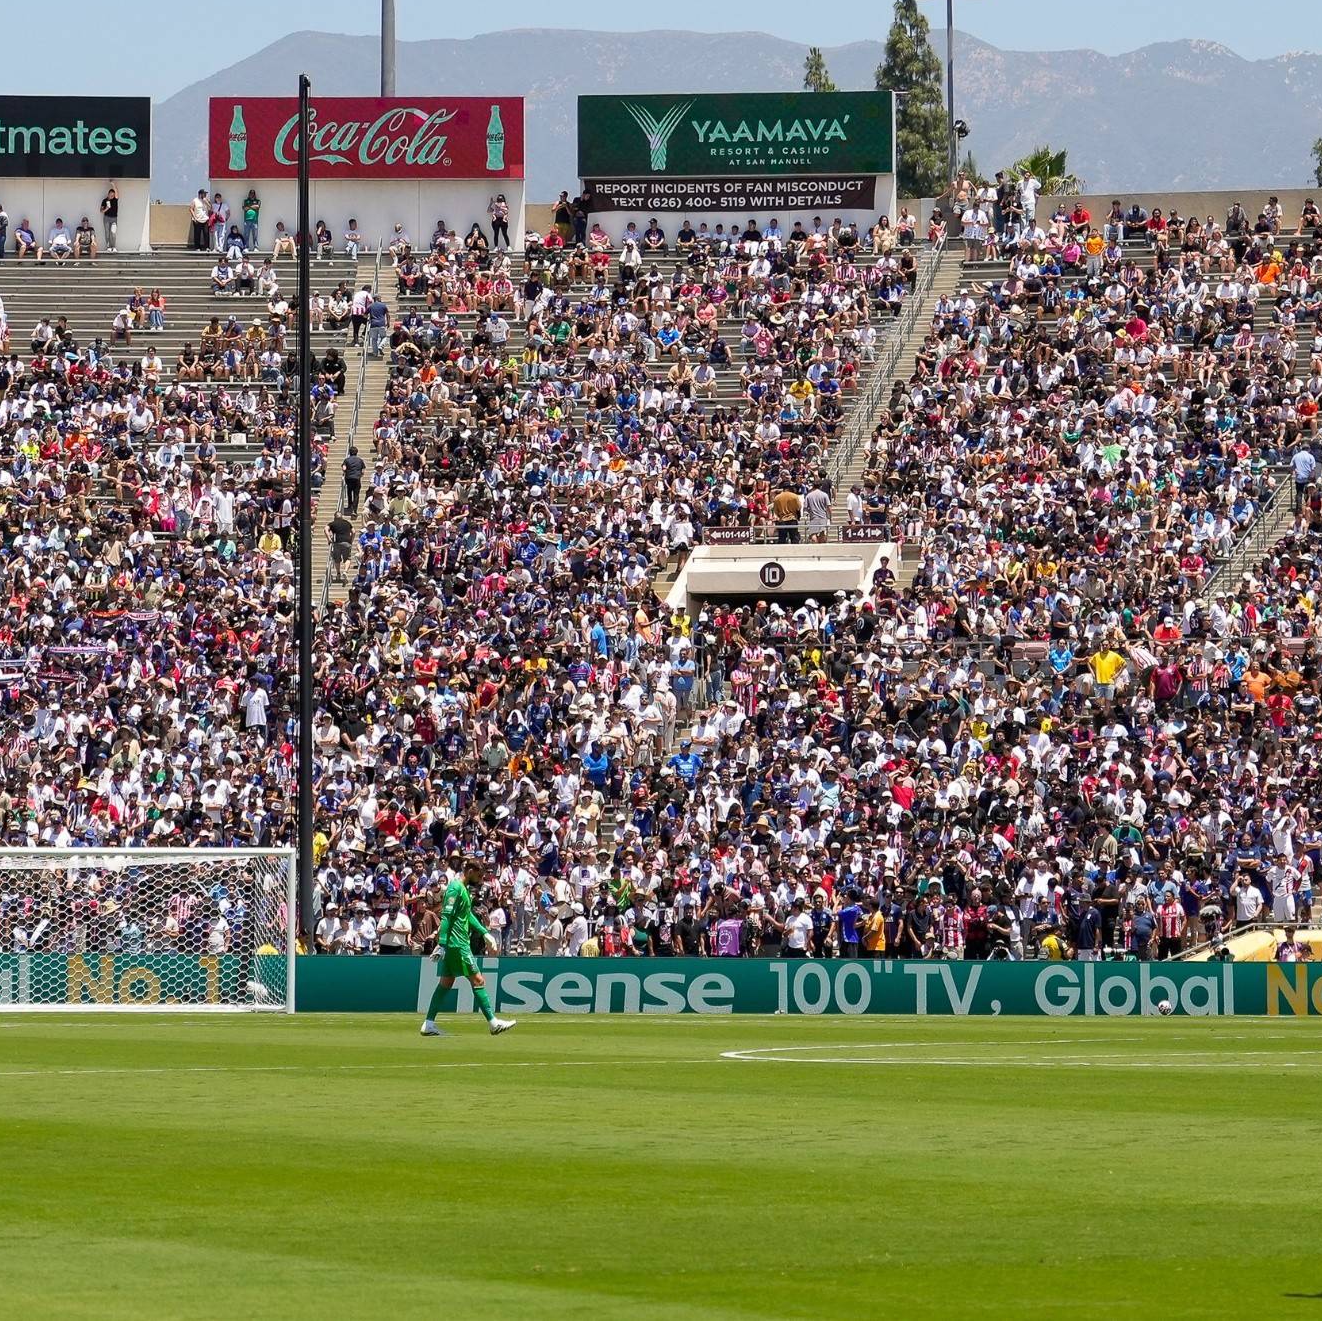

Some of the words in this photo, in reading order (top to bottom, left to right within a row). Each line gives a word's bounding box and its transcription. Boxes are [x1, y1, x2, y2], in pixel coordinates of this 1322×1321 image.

[710, 148, 759, 156] RESORT
[767, 147, 774, 155] &
[782, 146, 830, 155] CASINO
[746, 158, 766, 166] SAN
[770, 158, 812, 166] MANUEL
[596, 183, 646, 194] REPORT
[651, 182, 720, 194] INCIDENTS
[724, 182, 741, 193] OF
[746, 182, 772, 193] FAN
[777, 180, 863, 192] MISCONDUCT
[611, 197, 644, 208] TEXT
[647, 196, 682, 209] (626)
[720, 196, 746, 208] 5119
[750, 196, 785, 207] WITH
[788, 195, 842, 207] DETAILS
[721, 530, 750, 539] 101-141
[846, 529, 871, 538] 1-41
[765, 568, 779, 583] 10
[201, 954, 221, 1006] 1
[770, 962, 893, 1015] 100"
[903, 963, 1002, 1016] TV,
[1034, 962, 1235, 1016] Global
